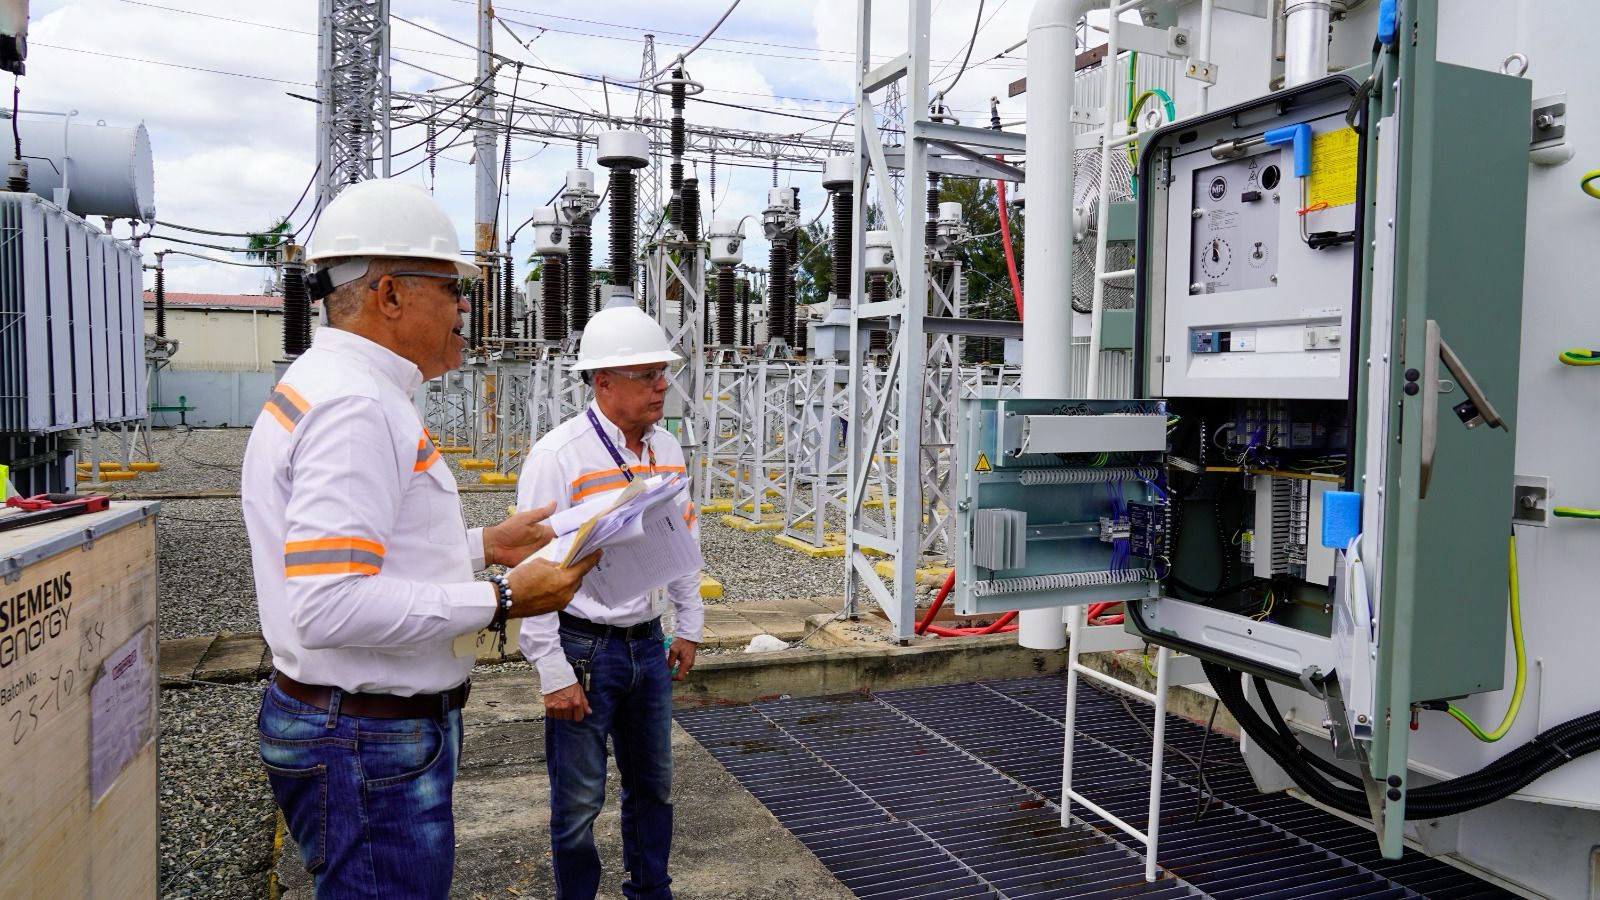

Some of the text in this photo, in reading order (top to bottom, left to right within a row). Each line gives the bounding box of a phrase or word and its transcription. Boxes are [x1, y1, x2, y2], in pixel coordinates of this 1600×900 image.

[1211, 184, 1225, 195] MR
[0, 571, 72, 633] SIEMENS
[0, 677, 25, 706] Batch
